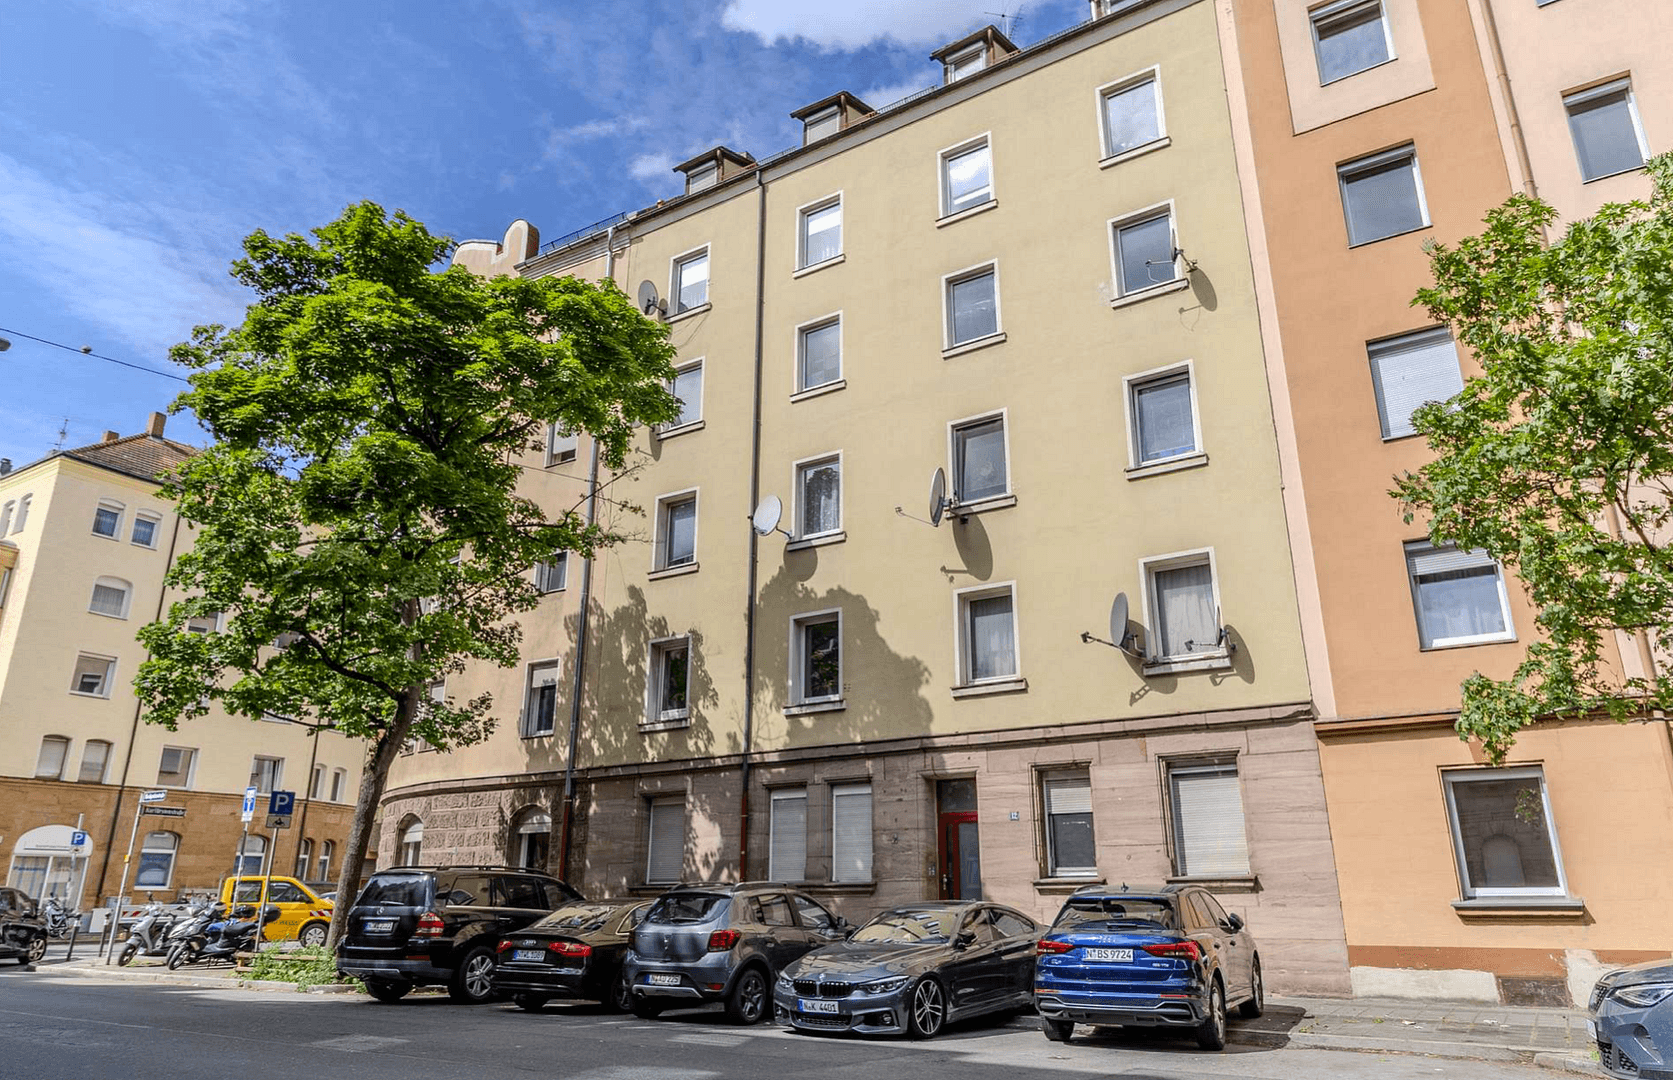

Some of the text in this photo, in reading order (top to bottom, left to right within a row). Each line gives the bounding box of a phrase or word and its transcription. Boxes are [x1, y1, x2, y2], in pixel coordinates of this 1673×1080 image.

[275, 794, 289, 811] P
[73, 833, 84, 844] P
[1086, 949, 1132, 959] N BS 9724
[819, 1003, 836, 1013] 4401
